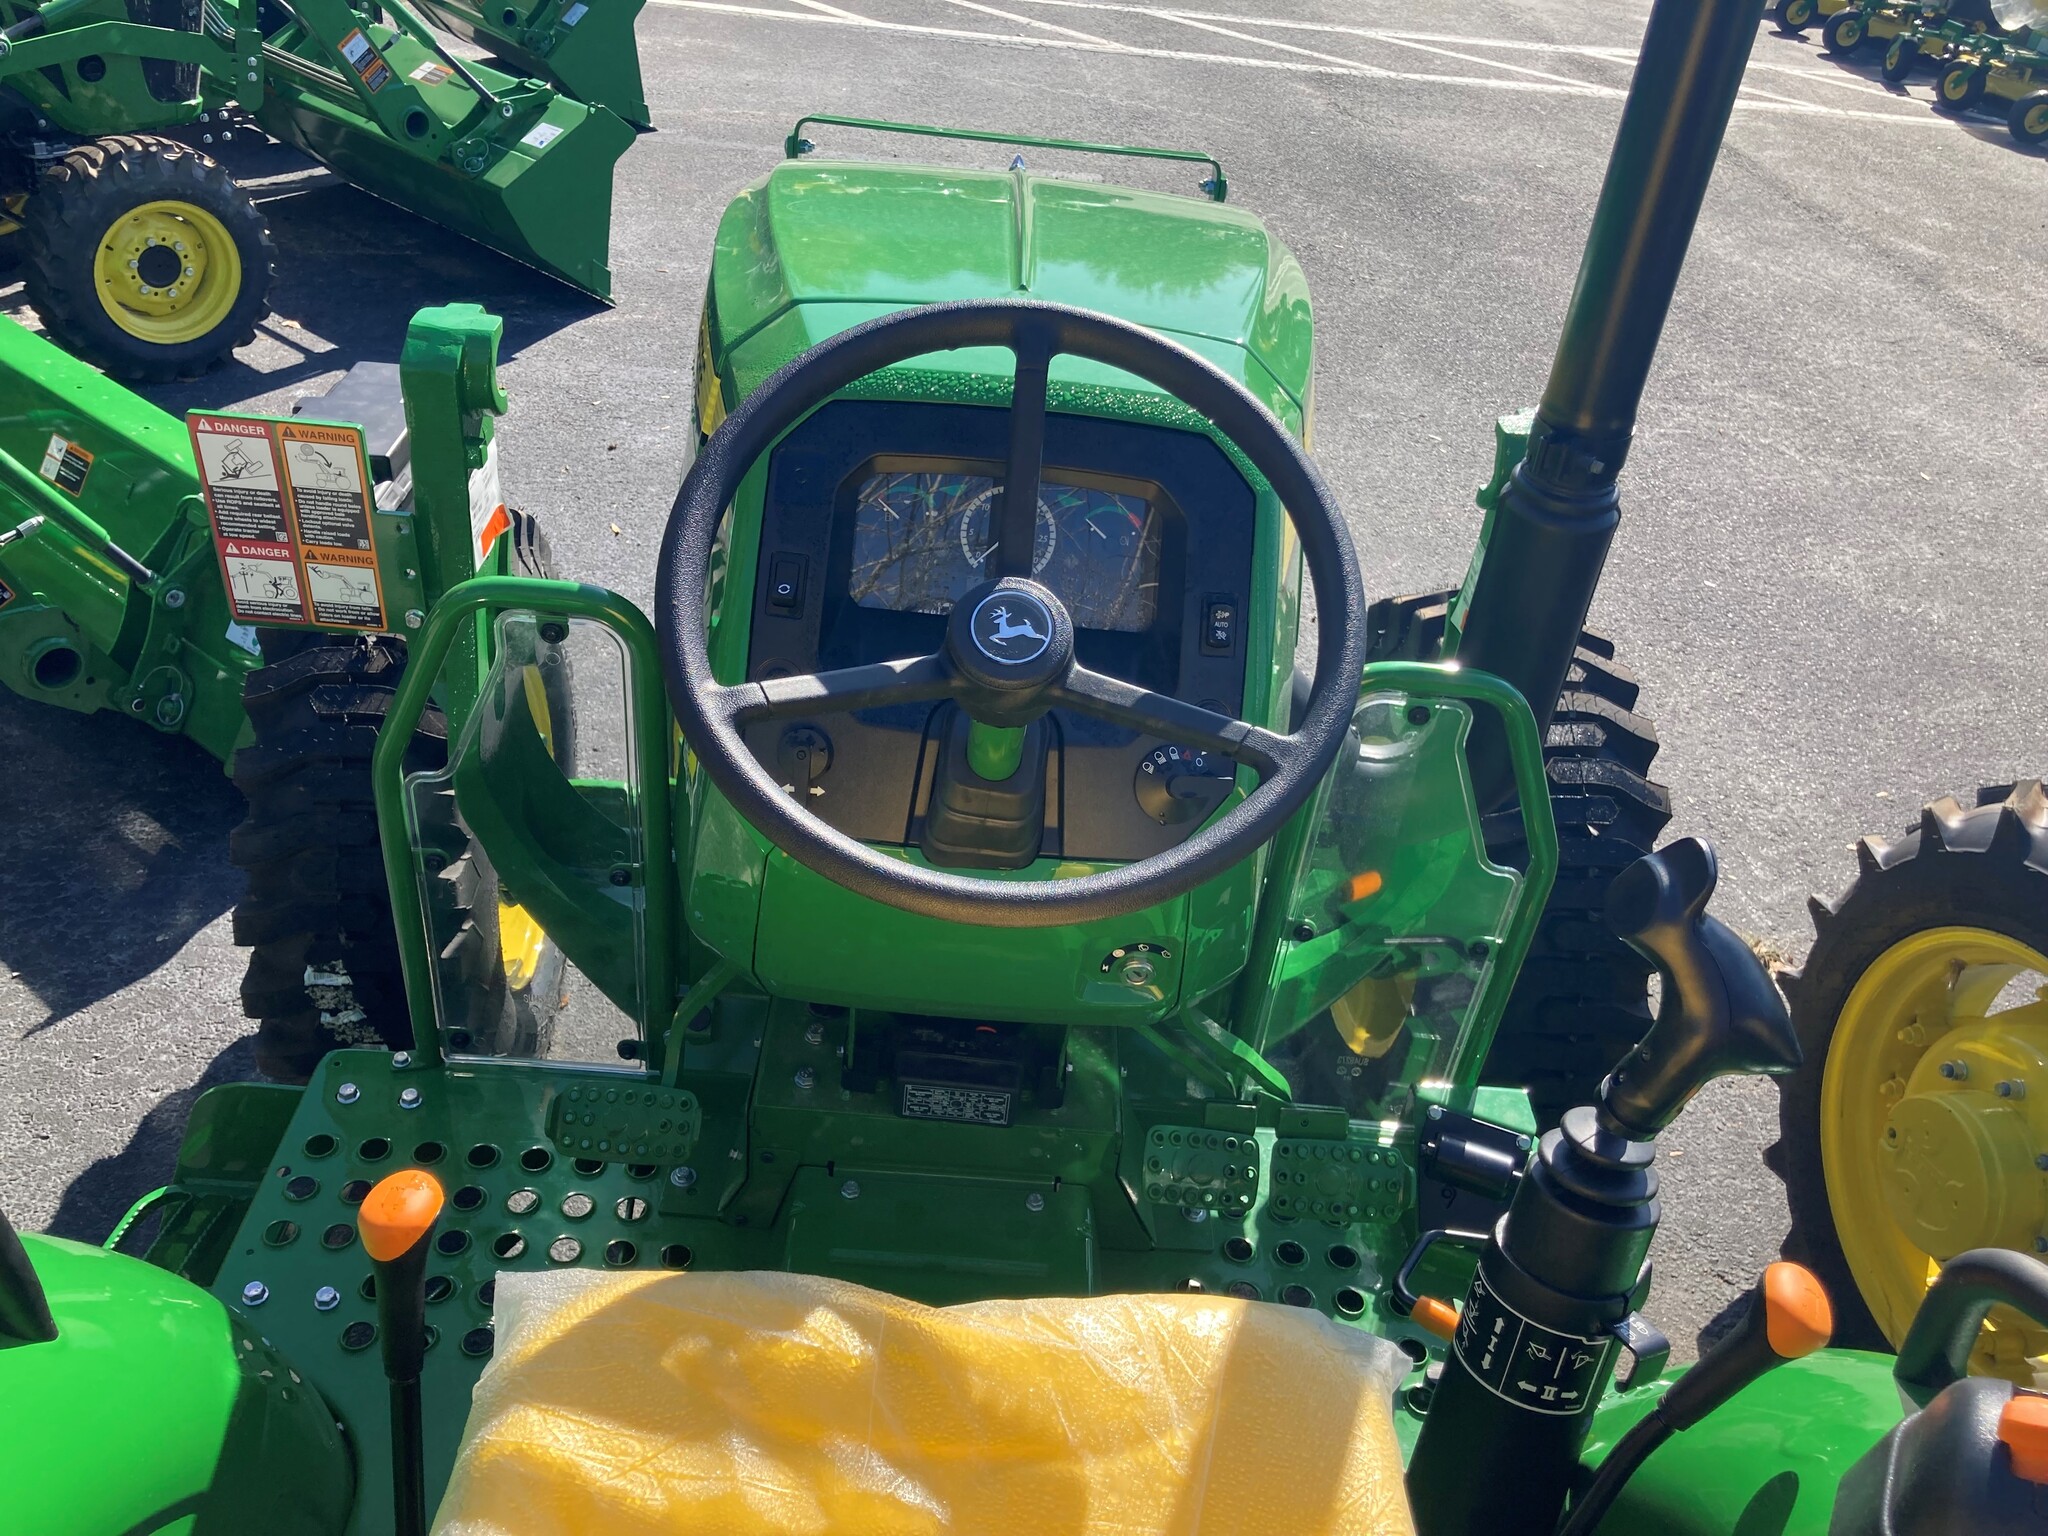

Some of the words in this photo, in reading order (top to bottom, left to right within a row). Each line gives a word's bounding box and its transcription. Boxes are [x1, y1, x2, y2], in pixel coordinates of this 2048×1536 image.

[214, 423, 265, 435] DANGER
[299, 430, 354, 442] WARNING
[242, 546, 289, 557] DANGER
[320, 553, 373, 564] WARNING
